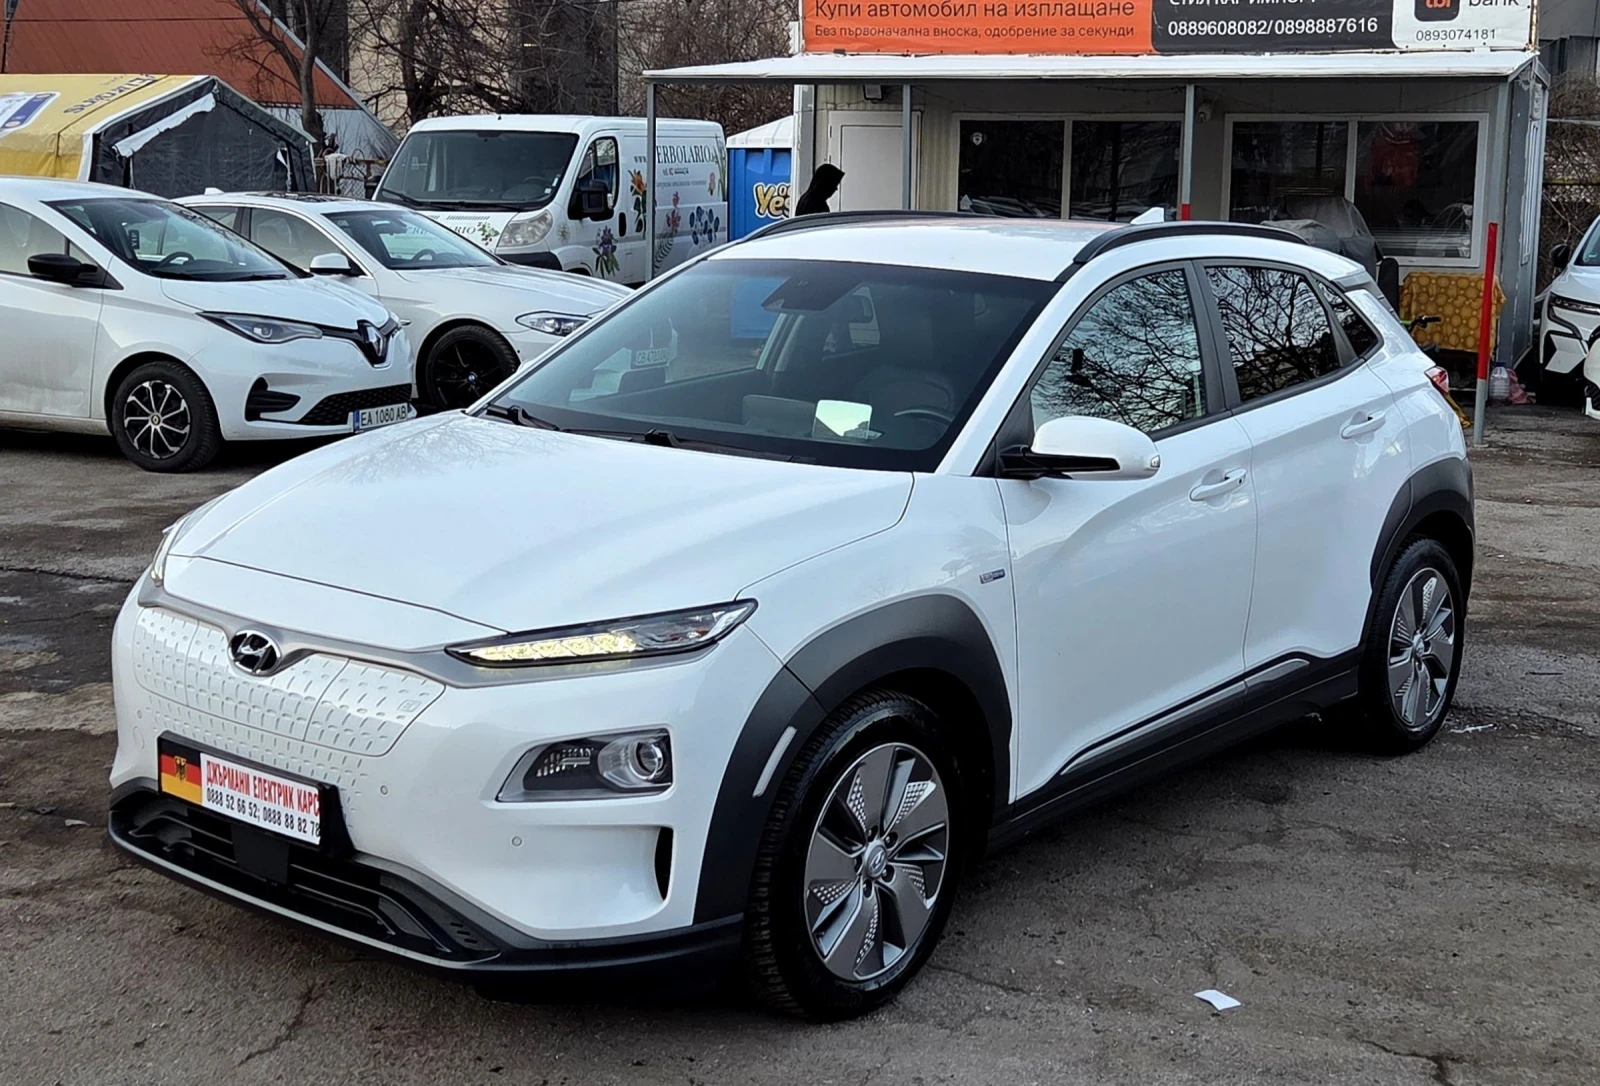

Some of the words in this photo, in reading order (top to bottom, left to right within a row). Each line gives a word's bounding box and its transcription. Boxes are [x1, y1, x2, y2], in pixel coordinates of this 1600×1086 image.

[815, 0, 861, 19] Купи
[867, 0, 977, 17] автомобил
[984, 3, 1008, 16] на
[1013, 2, 1135, 18] изплащане
[815, 25, 837, 37] Без
[840, 25, 930, 38] първоначална
[933, 26, 982, 39] вноска,
[984, 25, 1057, 39] одобрение
[1060, 27, 1076, 37] за
[1078, 26, 1135, 38] секунди
[1168, 18, 1378, 35] 0889608082/0898887616
[1416, 28, 1497, 42] 0893074181
[361, 411, 372, 426] EA
[396, 405, 407, 421] AB
[206, 760, 250, 797] ДЖЪРМАНИ
[253, 776, 294, 810] ЕЛЕКТРИК
[206, 788, 224, 805] 0888
[226, 793, 235, 811] 52
[237, 797, 247, 815] 66
[263, 806, 282, 827] 0888
[284, 813, 295, 832] 88
[297, 817, 308, 834] 82
